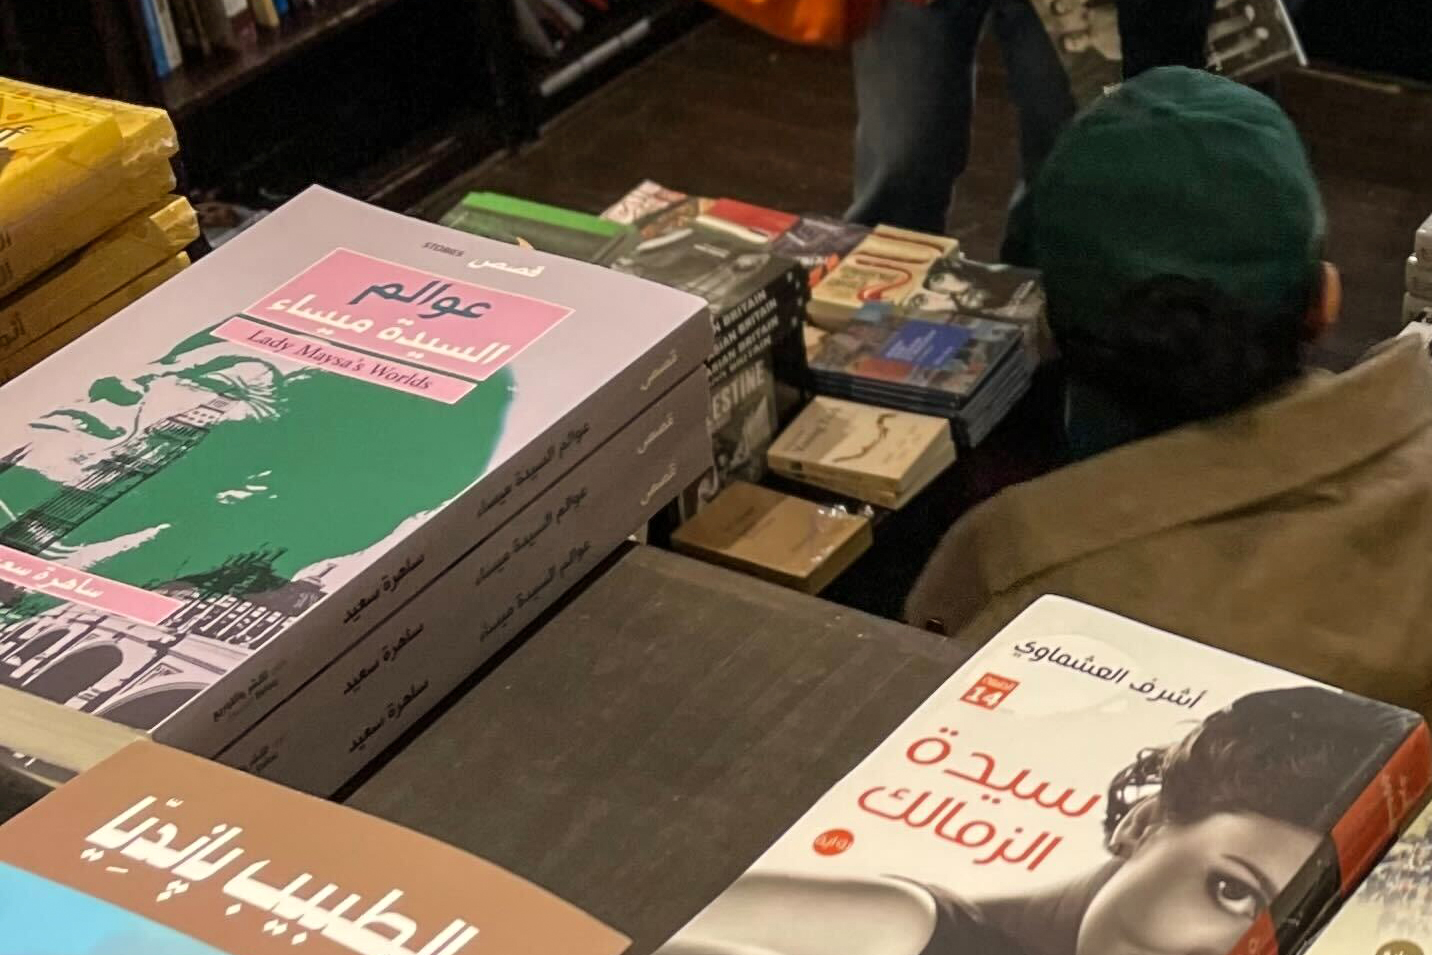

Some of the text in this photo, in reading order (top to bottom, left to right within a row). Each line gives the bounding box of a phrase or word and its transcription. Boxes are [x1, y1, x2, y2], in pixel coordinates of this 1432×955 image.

[347, 280, 492, 319] عوالم
[468, 258, 545, 278] قصص
[247, 328, 433, 391] Lady Maysa's Worlds
[266, 293, 511, 364] السيدة ميساء
[0, 558, 104, 598] ساهرة سع
[343, 554, 425, 624] ساهرة سعيد
[343, 624, 424, 695] ساهرة سعيد
[1013, 639, 1208, 710] أشرف العشماوي
[350, 680, 429, 753] ساهرة سعيد
[965, 686, 1004, 708] 14
[906, 726, 1102, 818] سيدة
[858, 786, 1065, 872] الزمالك
[223, 859, 480, 955] الطبيب
